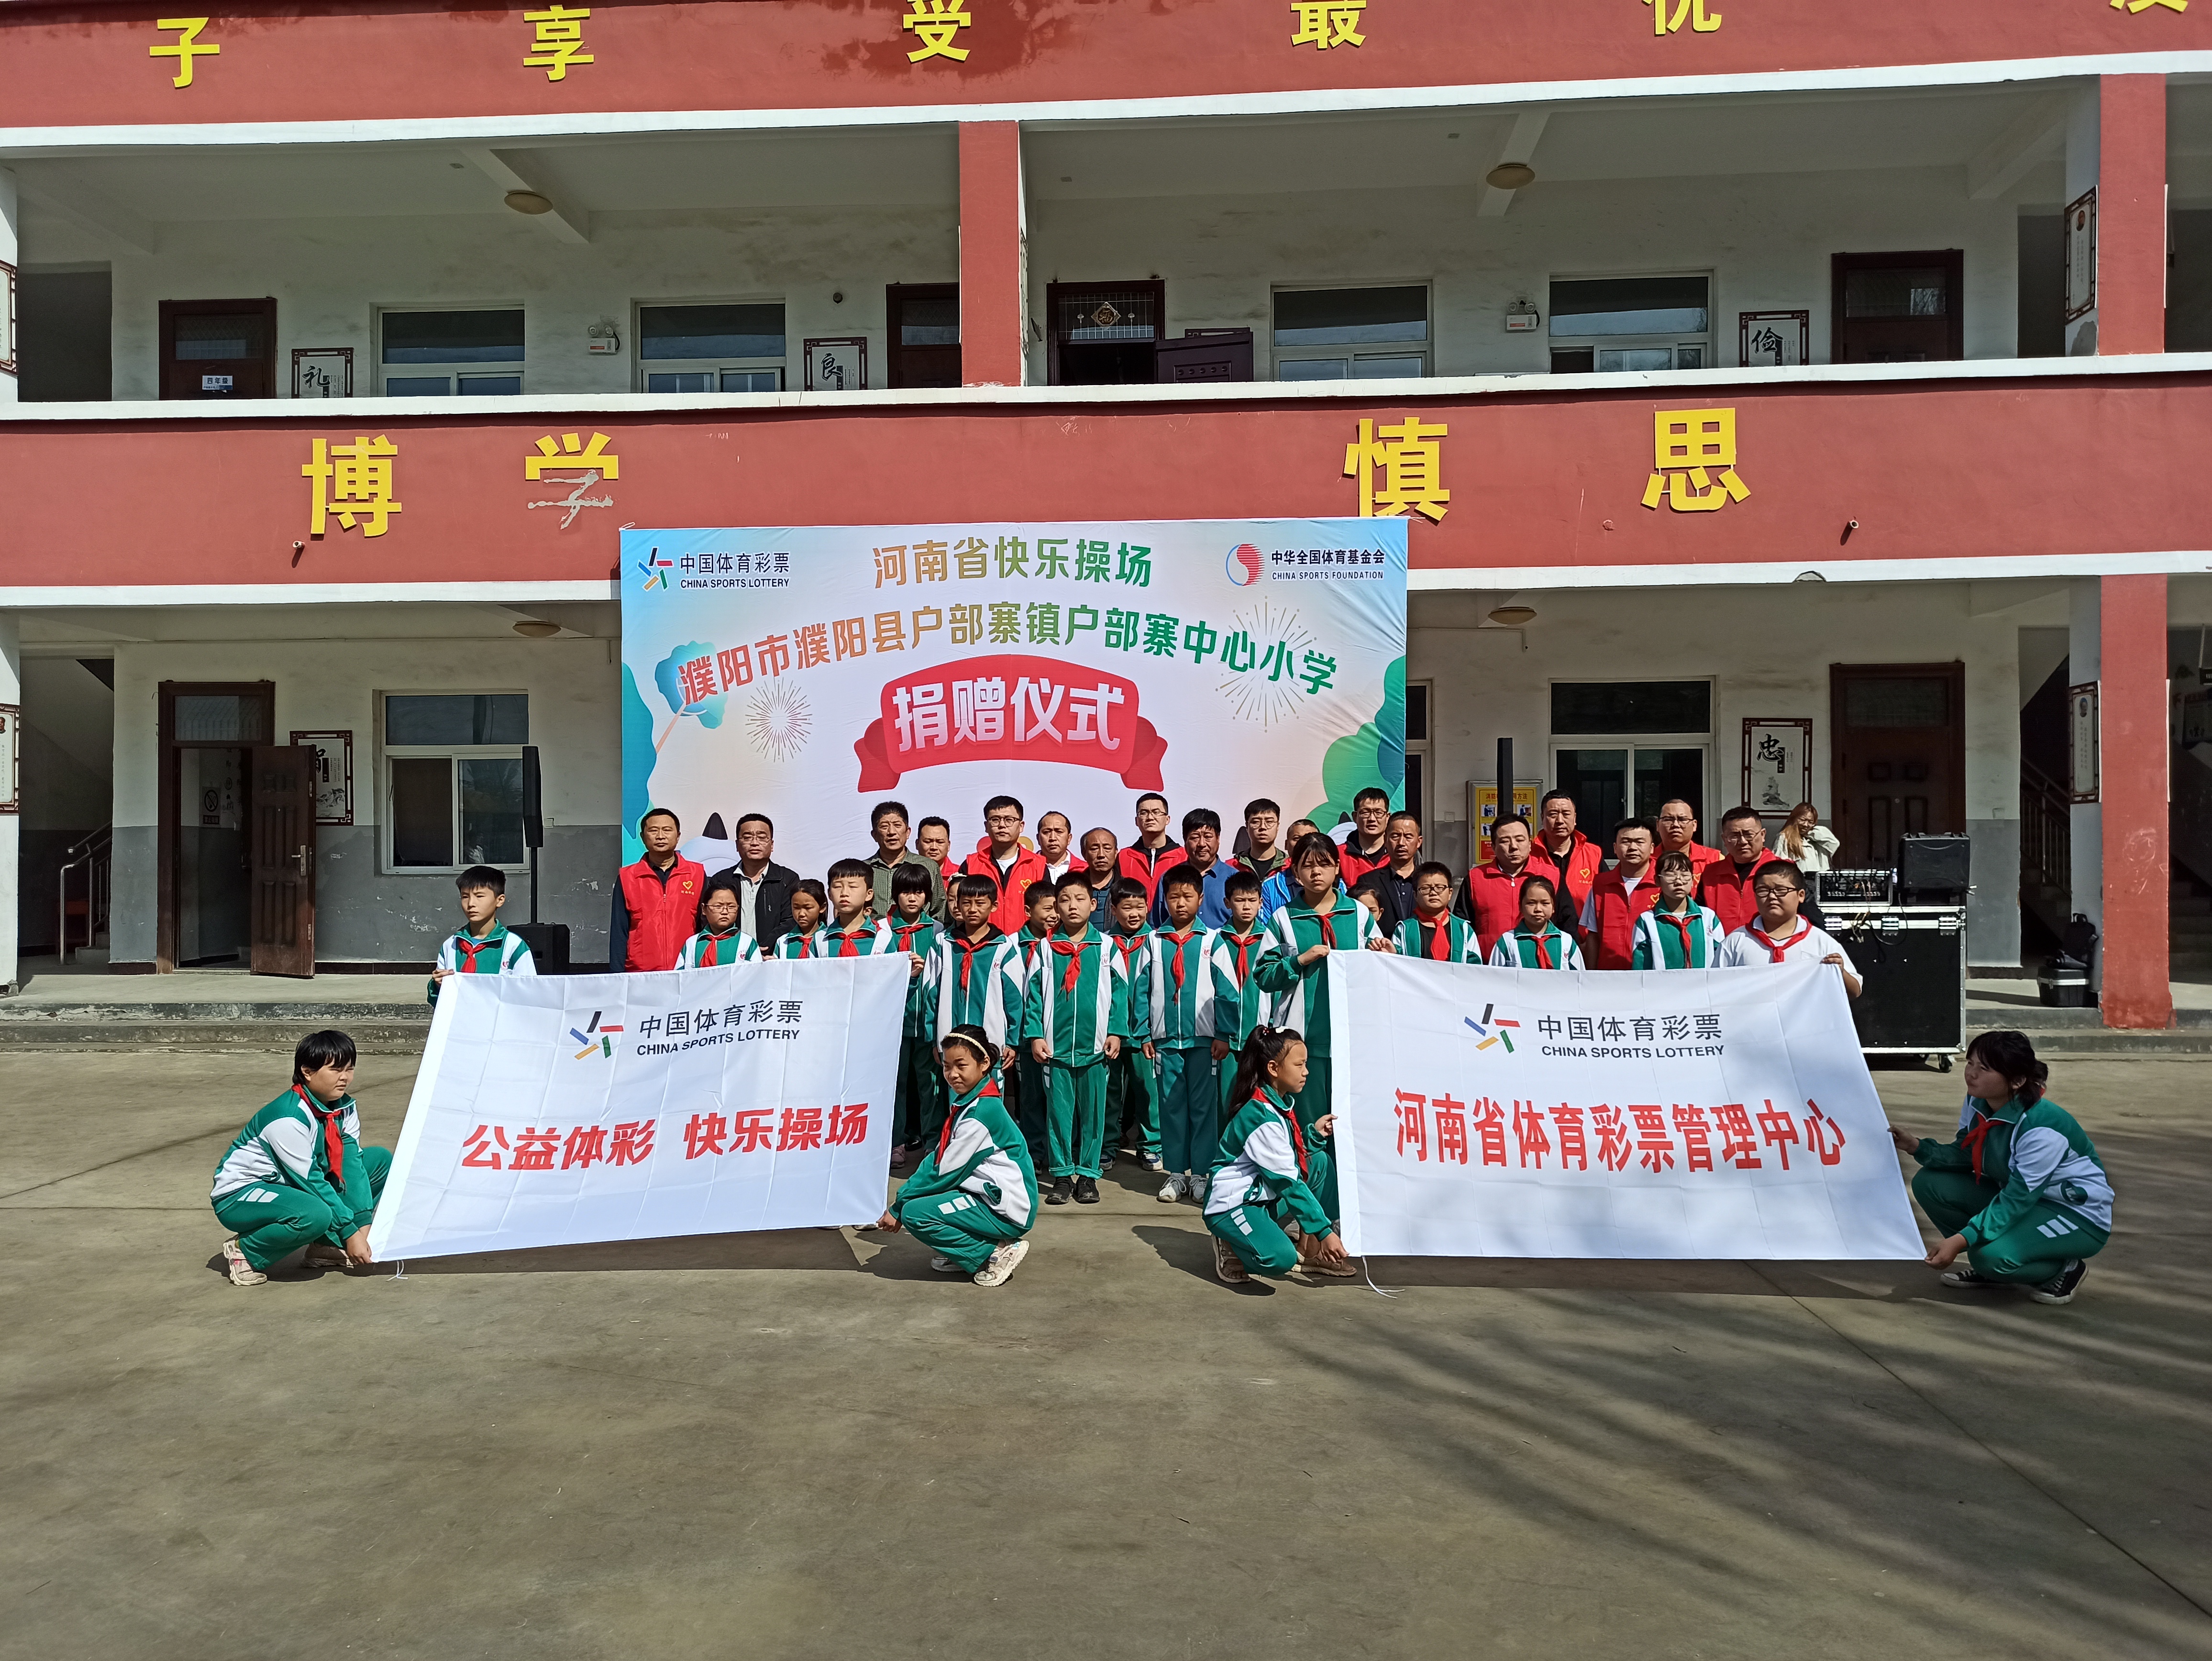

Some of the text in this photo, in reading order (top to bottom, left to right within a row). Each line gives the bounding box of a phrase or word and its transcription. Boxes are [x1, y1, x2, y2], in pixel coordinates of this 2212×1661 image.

[680, 552, 790, 575] 中国体育彩票
[874, 536, 1152, 589] 河南省快乐操场
[1271, 549, 1385, 566] 中华全国体育基金会
[681, 578, 789, 589] CHINA SPORTS LOTTERY
[1272, 571, 1384, 580] CHINA SPORTS FOUNDATION
[677, 601, 1338, 707] 濮阳市濮阳县户部寨镇户部寨中心小学
[892, 675, 1125, 753] 捐赠仪式
[639, 999, 804, 1040] 中国体育彩票
[1537, 1014, 1722, 1042] 中国体育彩票
[637, 1029, 800, 1056] CHINA SPORTS LOTTERY
[1541, 1045, 1725, 1059] CHINA SPORTS LOTTERY
[462, 1103, 868, 1171] 公益体彩 快乐操场
[1394, 1087, 1846, 1173] 河南省体育彩票管理中心
